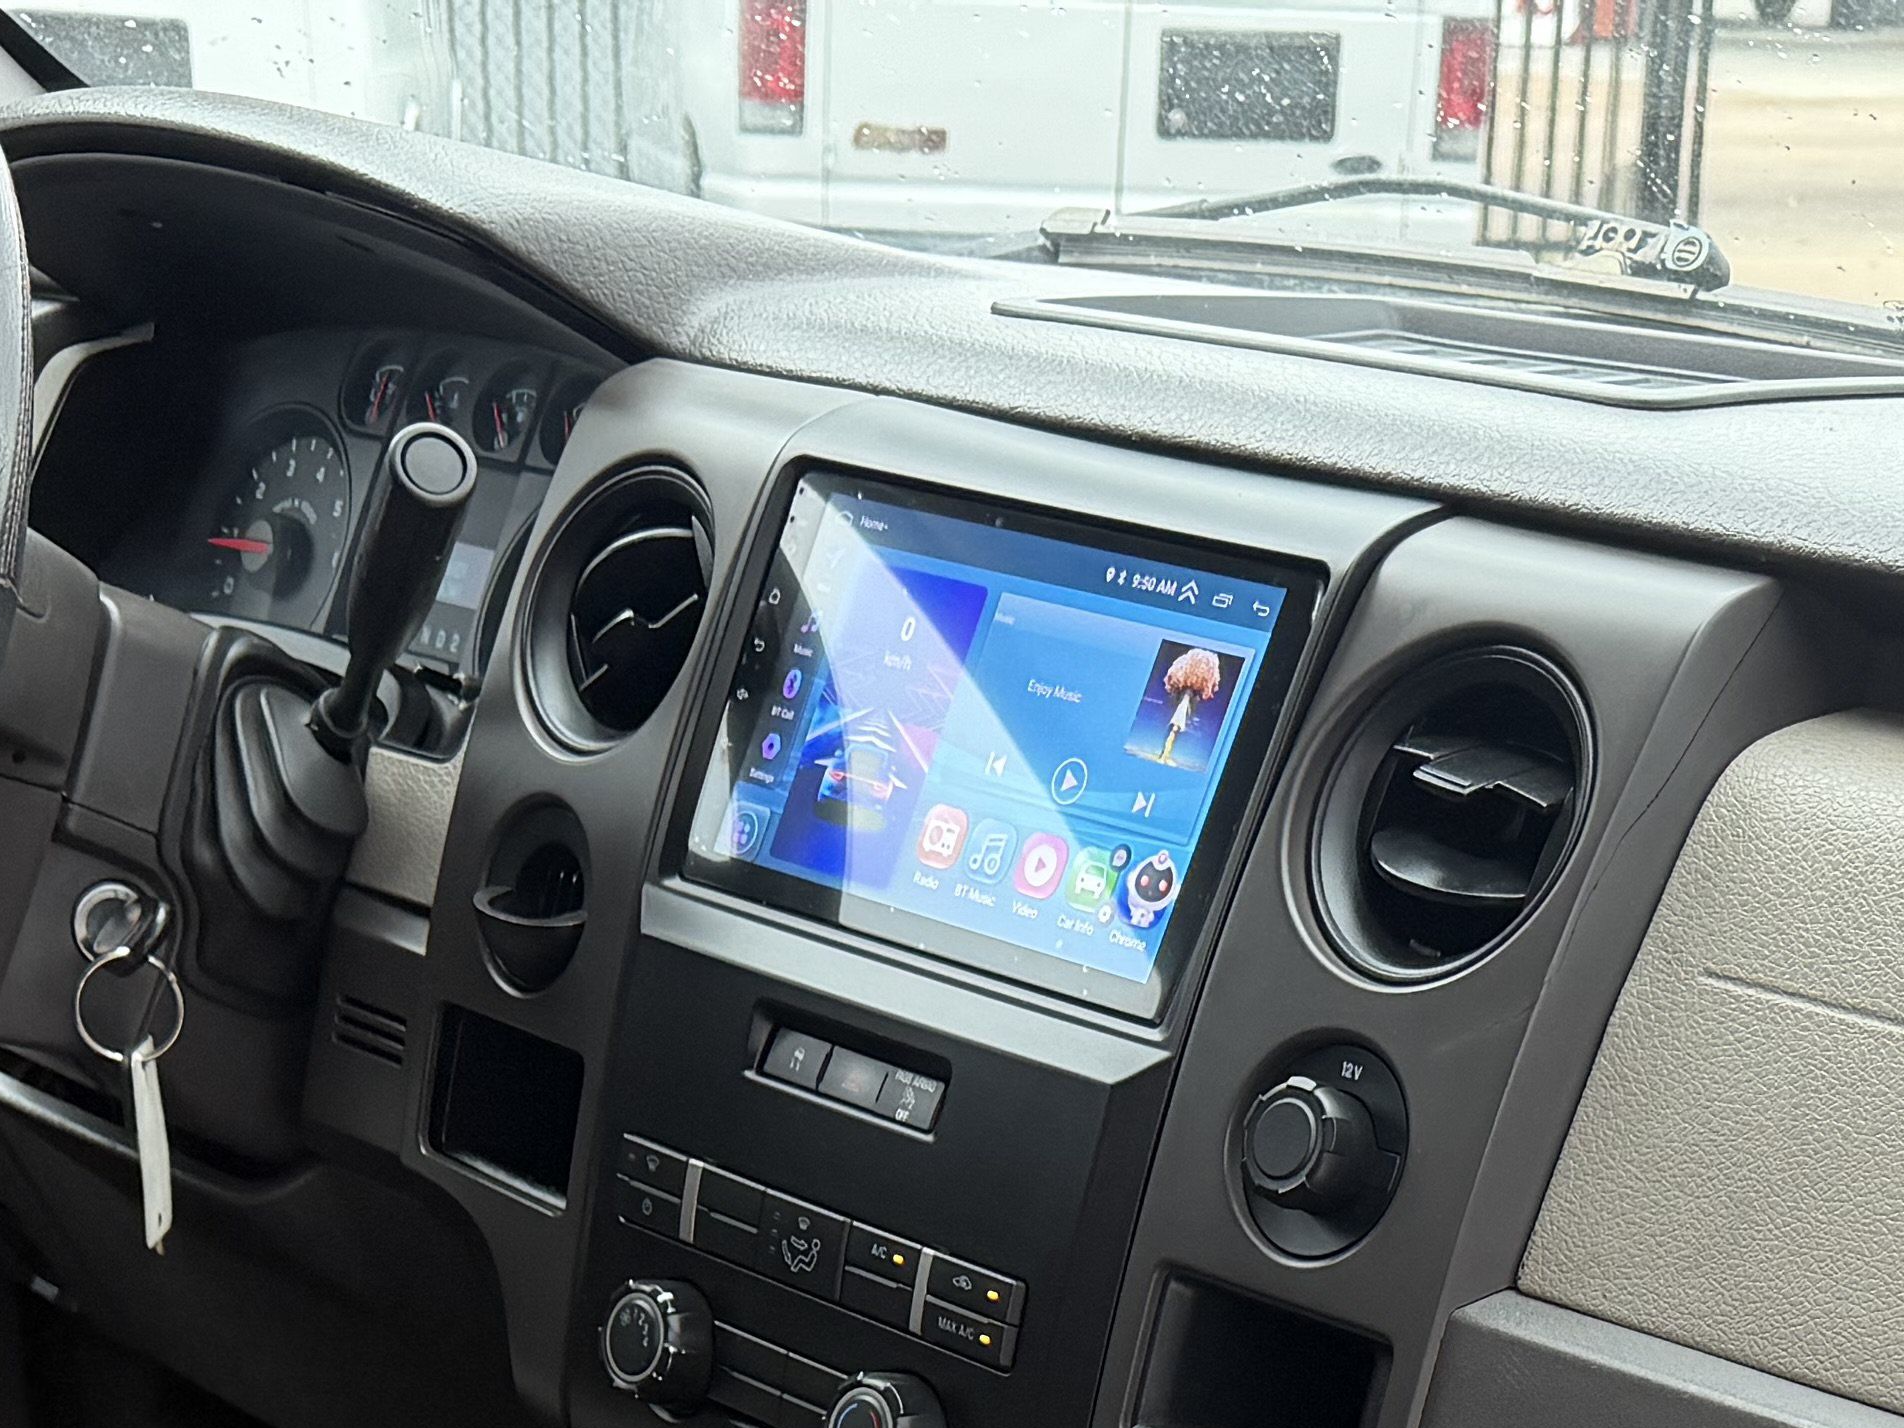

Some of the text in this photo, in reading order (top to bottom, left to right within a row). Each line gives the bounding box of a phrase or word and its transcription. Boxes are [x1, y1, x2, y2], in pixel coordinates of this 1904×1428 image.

[1132, 573, 1177, 597] 9:50 AM
[900, 616, 916, 642] 0
[884, 650, 913, 671] km/h
[1027, 678, 1083, 704] Enjoy Music
[912, 870, 940, 891] Radio
[954, 882, 997, 908] BT Music
[1012, 899, 1039, 920] Video
[1057, 914, 1075, 931] Car
[1109, 928, 1148, 954] Chrome
[1341, 1061, 1363, 1081] 12V
[871, 1243, 888, 1260] A/C
[937, 1316, 975, 1341] MAX A/C
